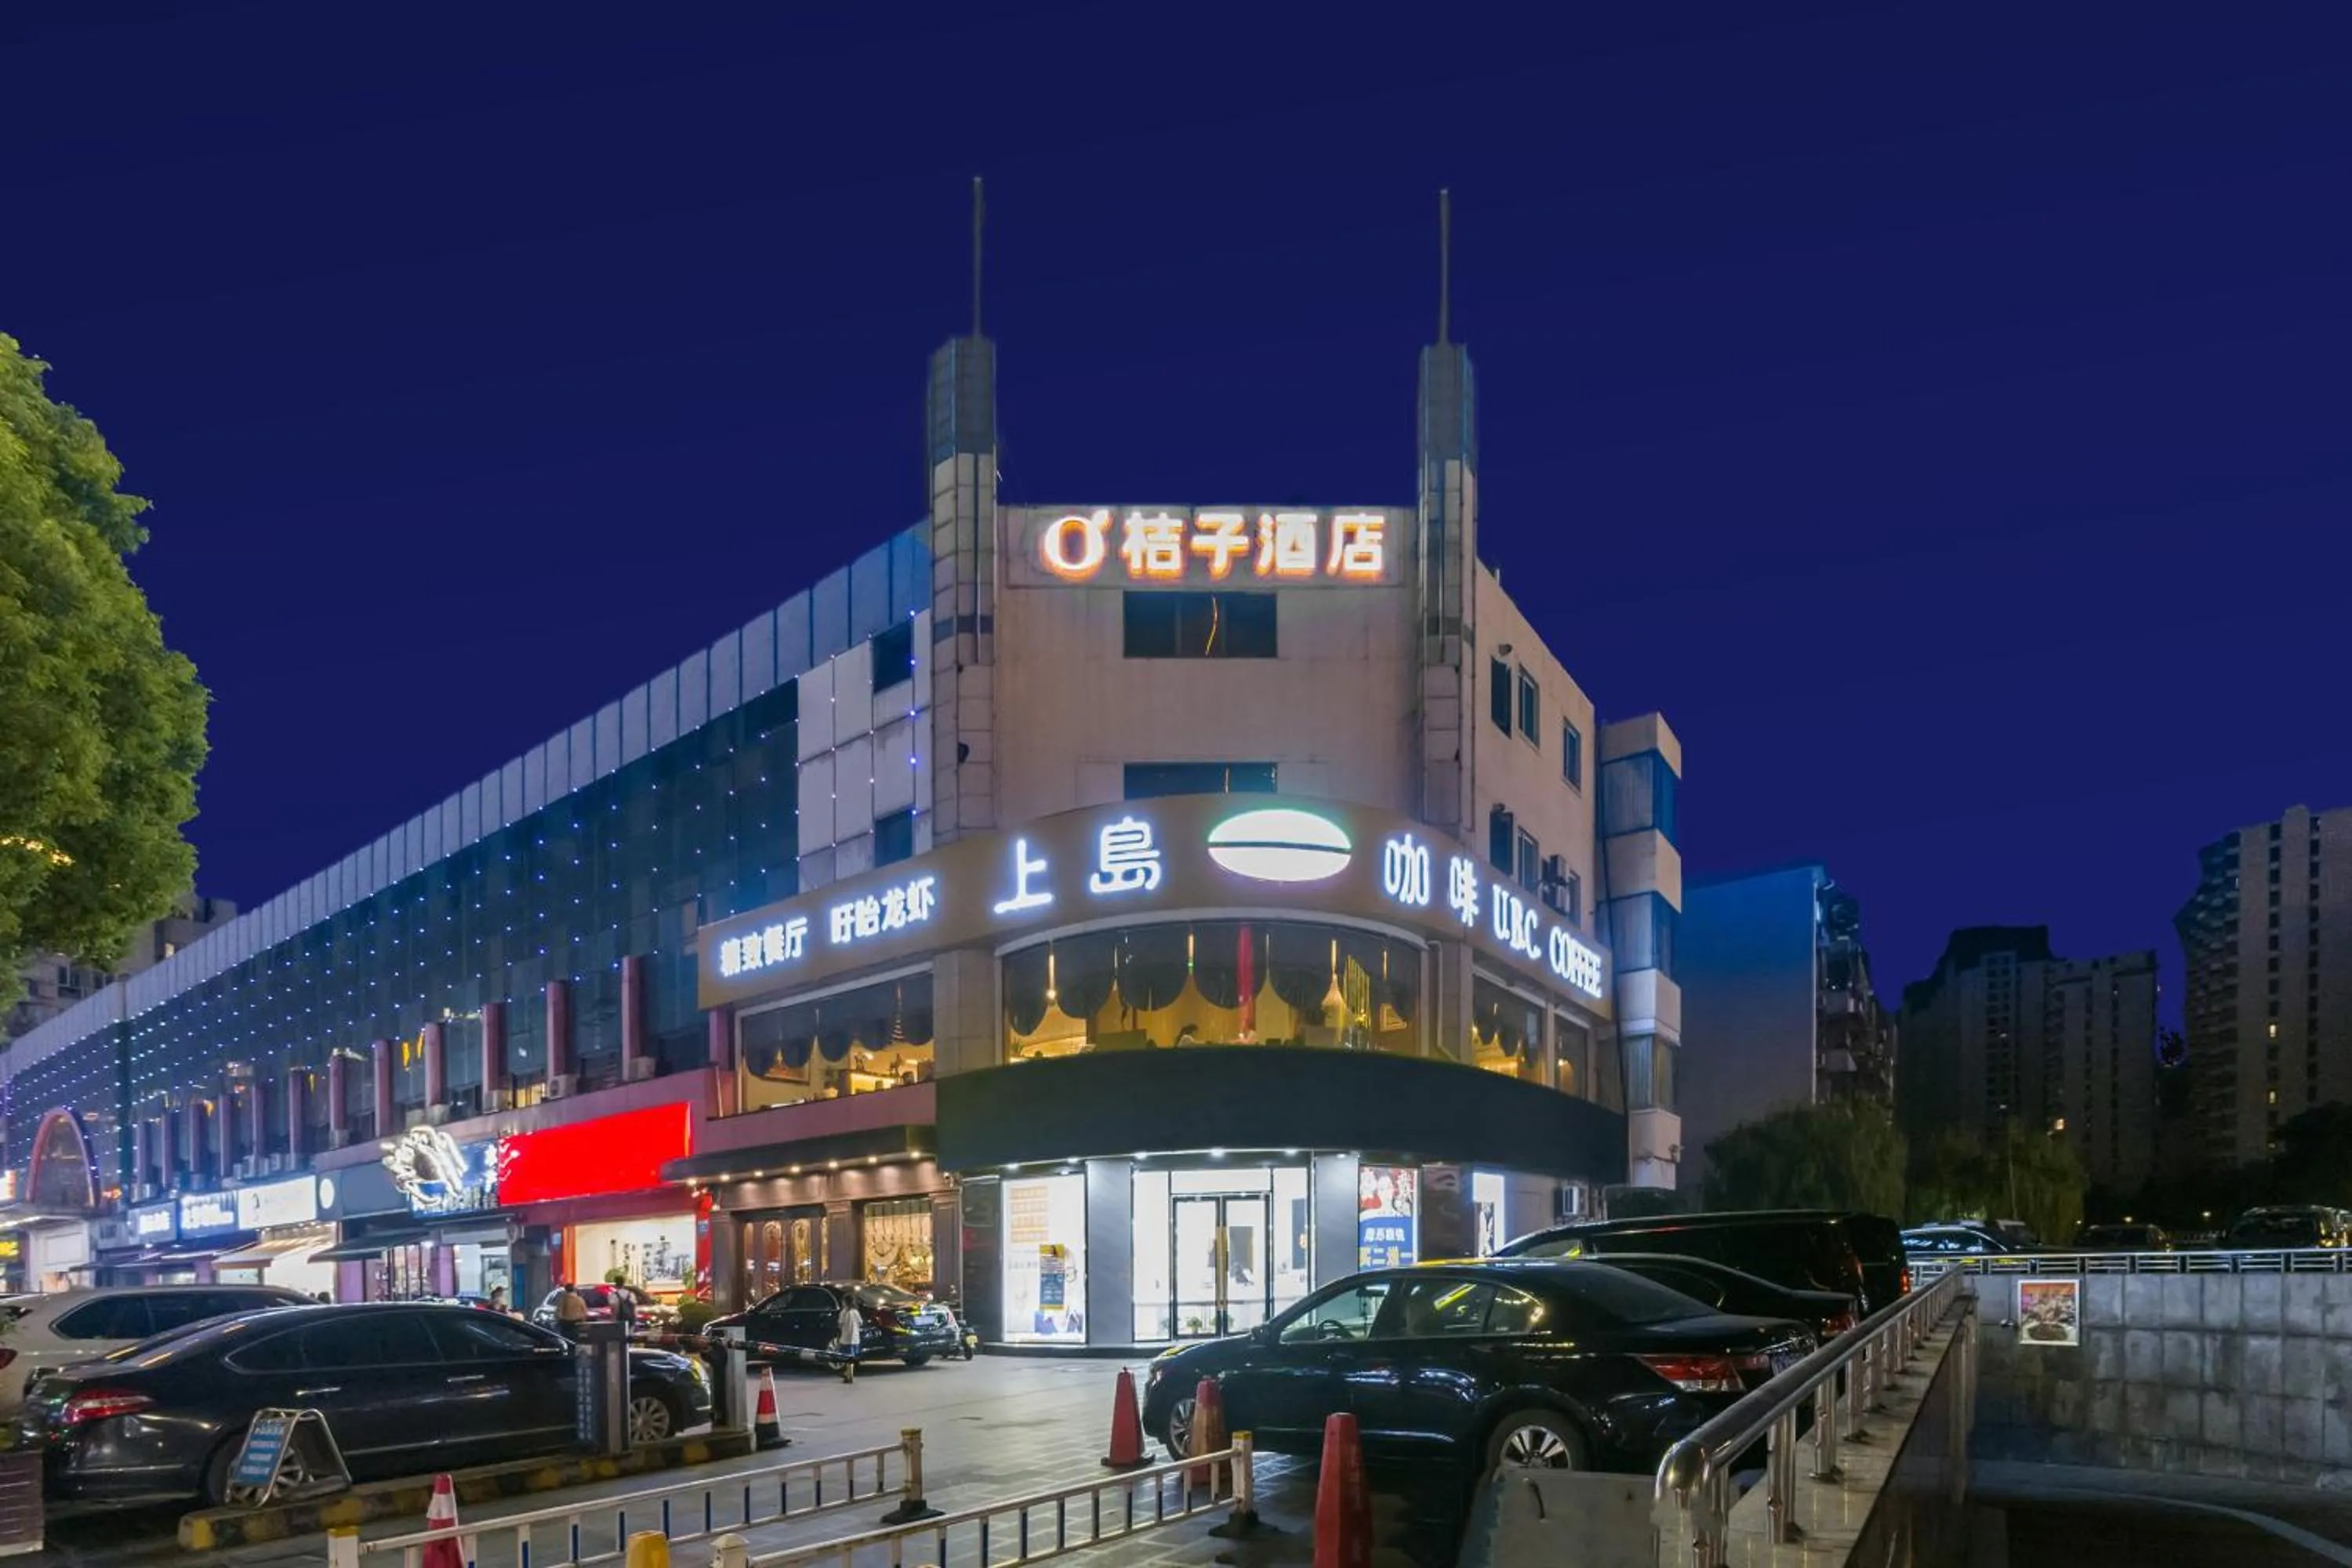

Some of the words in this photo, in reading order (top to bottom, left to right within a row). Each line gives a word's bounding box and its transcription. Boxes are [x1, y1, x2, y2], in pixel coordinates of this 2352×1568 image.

[1122, 511, 1385, 574] 桔子酒店
[831, 877, 935, 942] 盱眙龙虾
[1385, 833, 1479, 927] 咖啡
[1550, 926, 1602, 998] COFFEE
